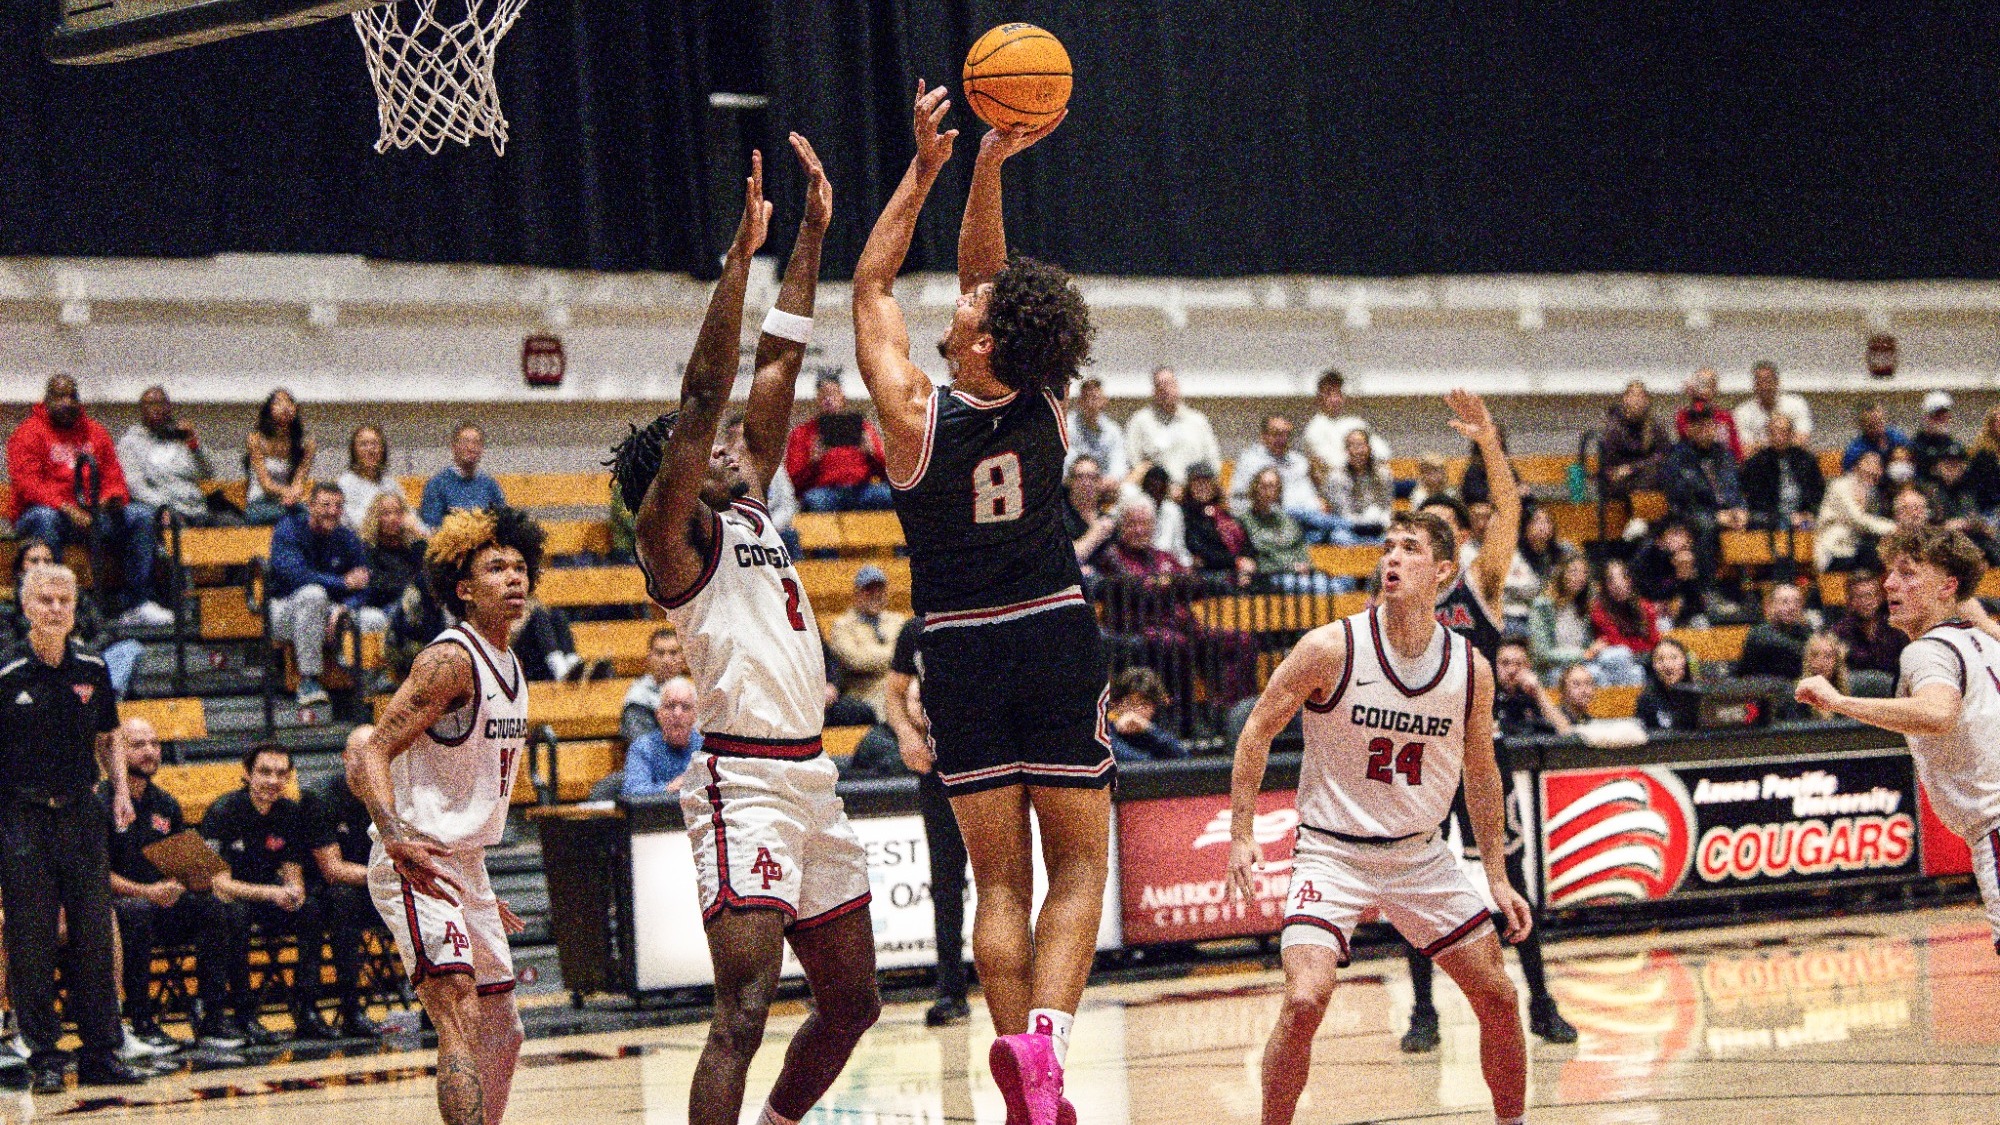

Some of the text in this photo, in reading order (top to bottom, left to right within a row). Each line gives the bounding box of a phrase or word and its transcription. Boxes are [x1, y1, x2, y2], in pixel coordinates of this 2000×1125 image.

[972, 450, 1025, 524] 8
[780, 577, 807, 632] 2
[1350, 703, 1453, 737] COUGARS
[1366, 736, 1426, 786] 24
[865, 839, 921, 867] EST
[1697, 814, 1914, 882] COUGARS
